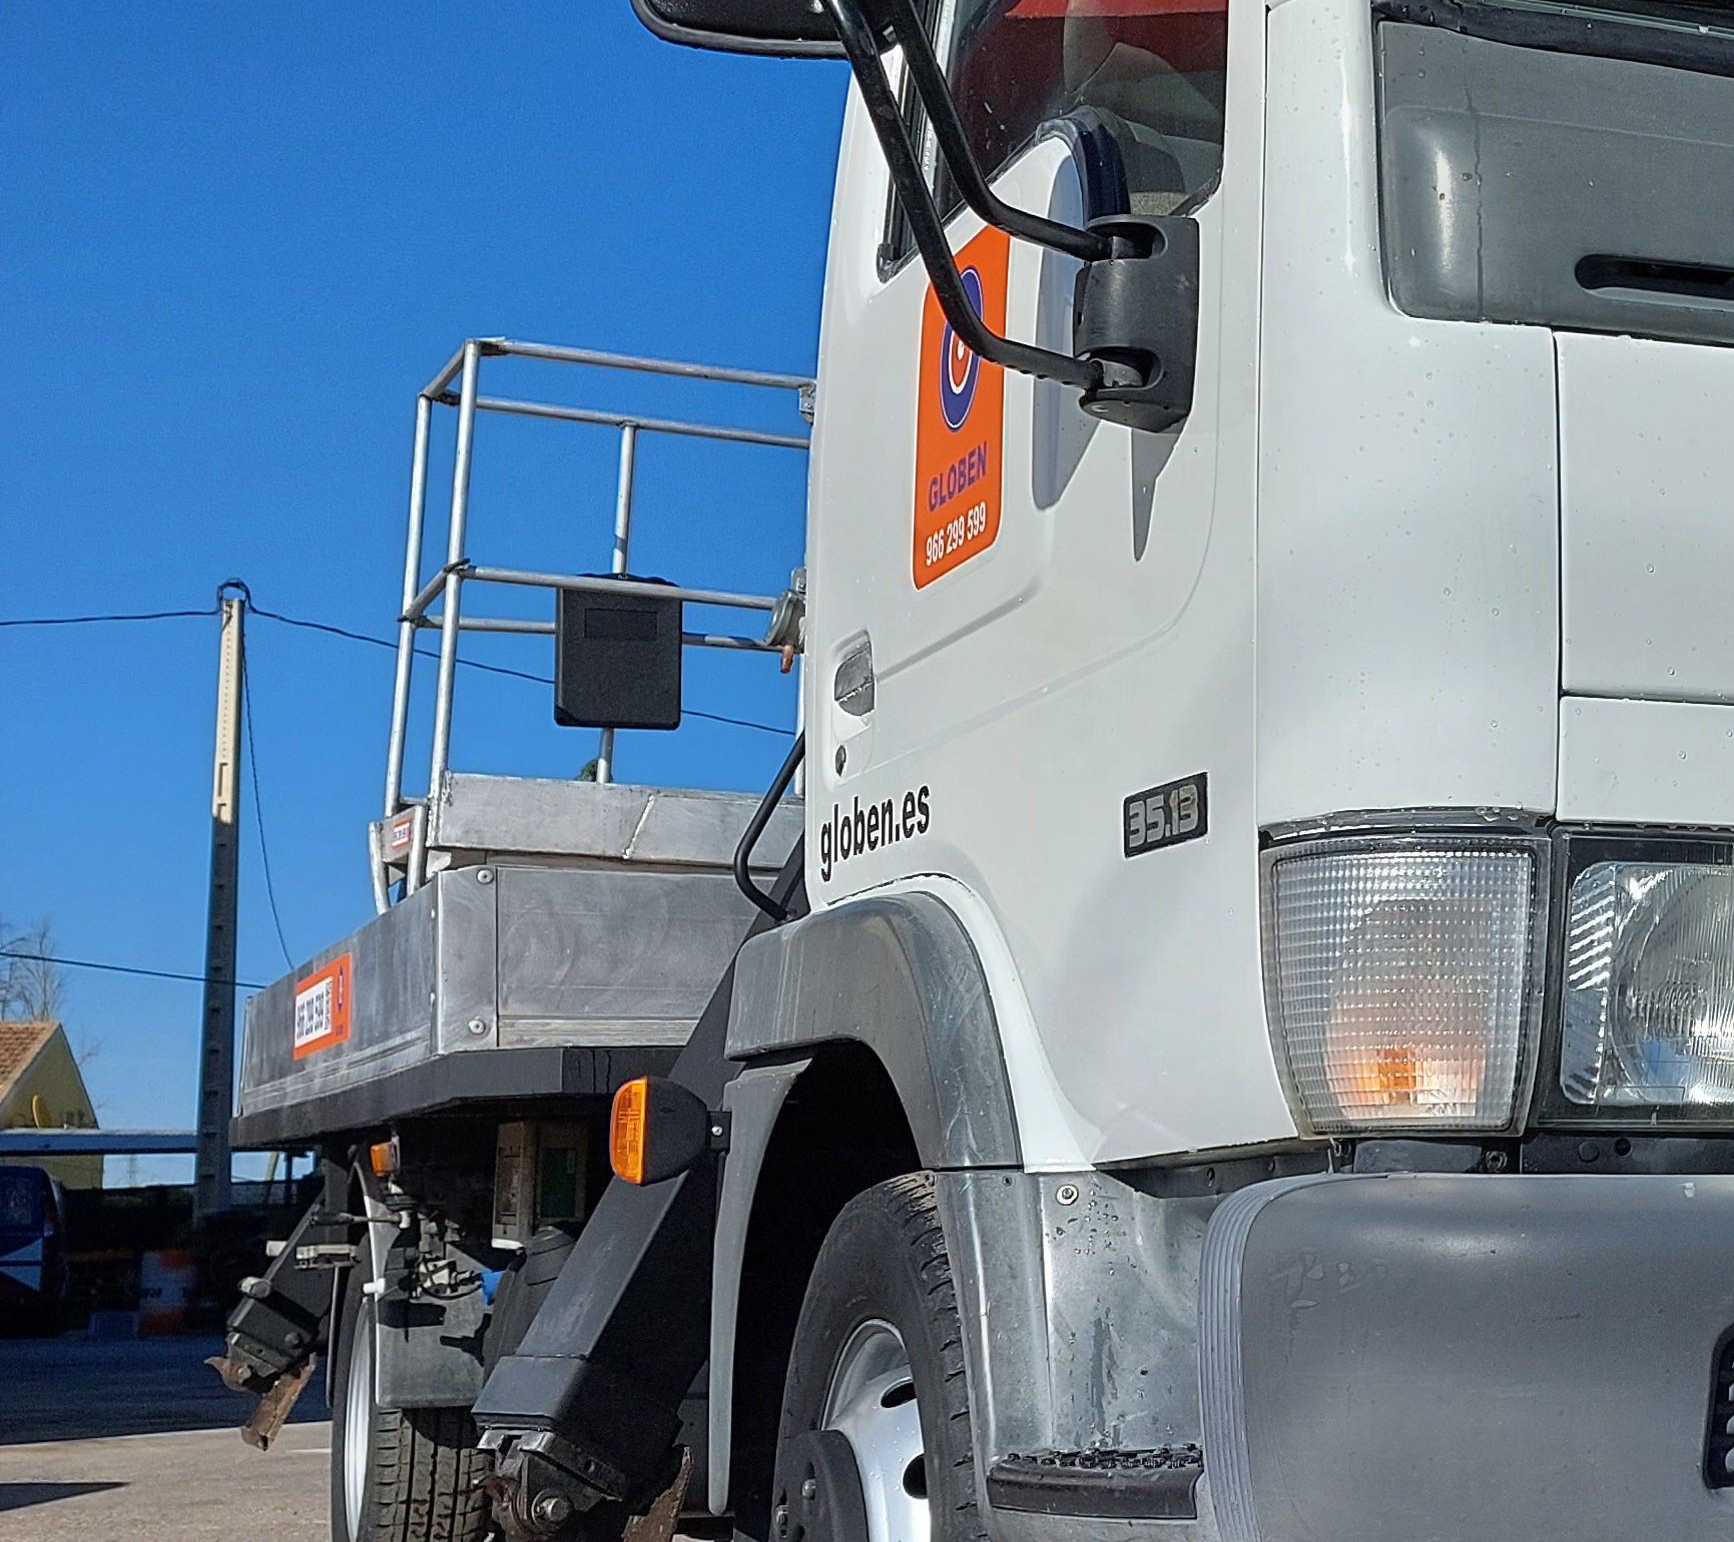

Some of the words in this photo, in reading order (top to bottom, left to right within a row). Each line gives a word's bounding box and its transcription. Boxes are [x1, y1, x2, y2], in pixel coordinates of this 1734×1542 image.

[928, 440, 987, 513] GLOBEN
[925, 528, 945, 566] 966
[946, 515, 965, 554] 299
[967, 501, 987, 540] 599
[820, 785, 930, 882] globen.es
[1129, 784, 1199, 848] 35.13
